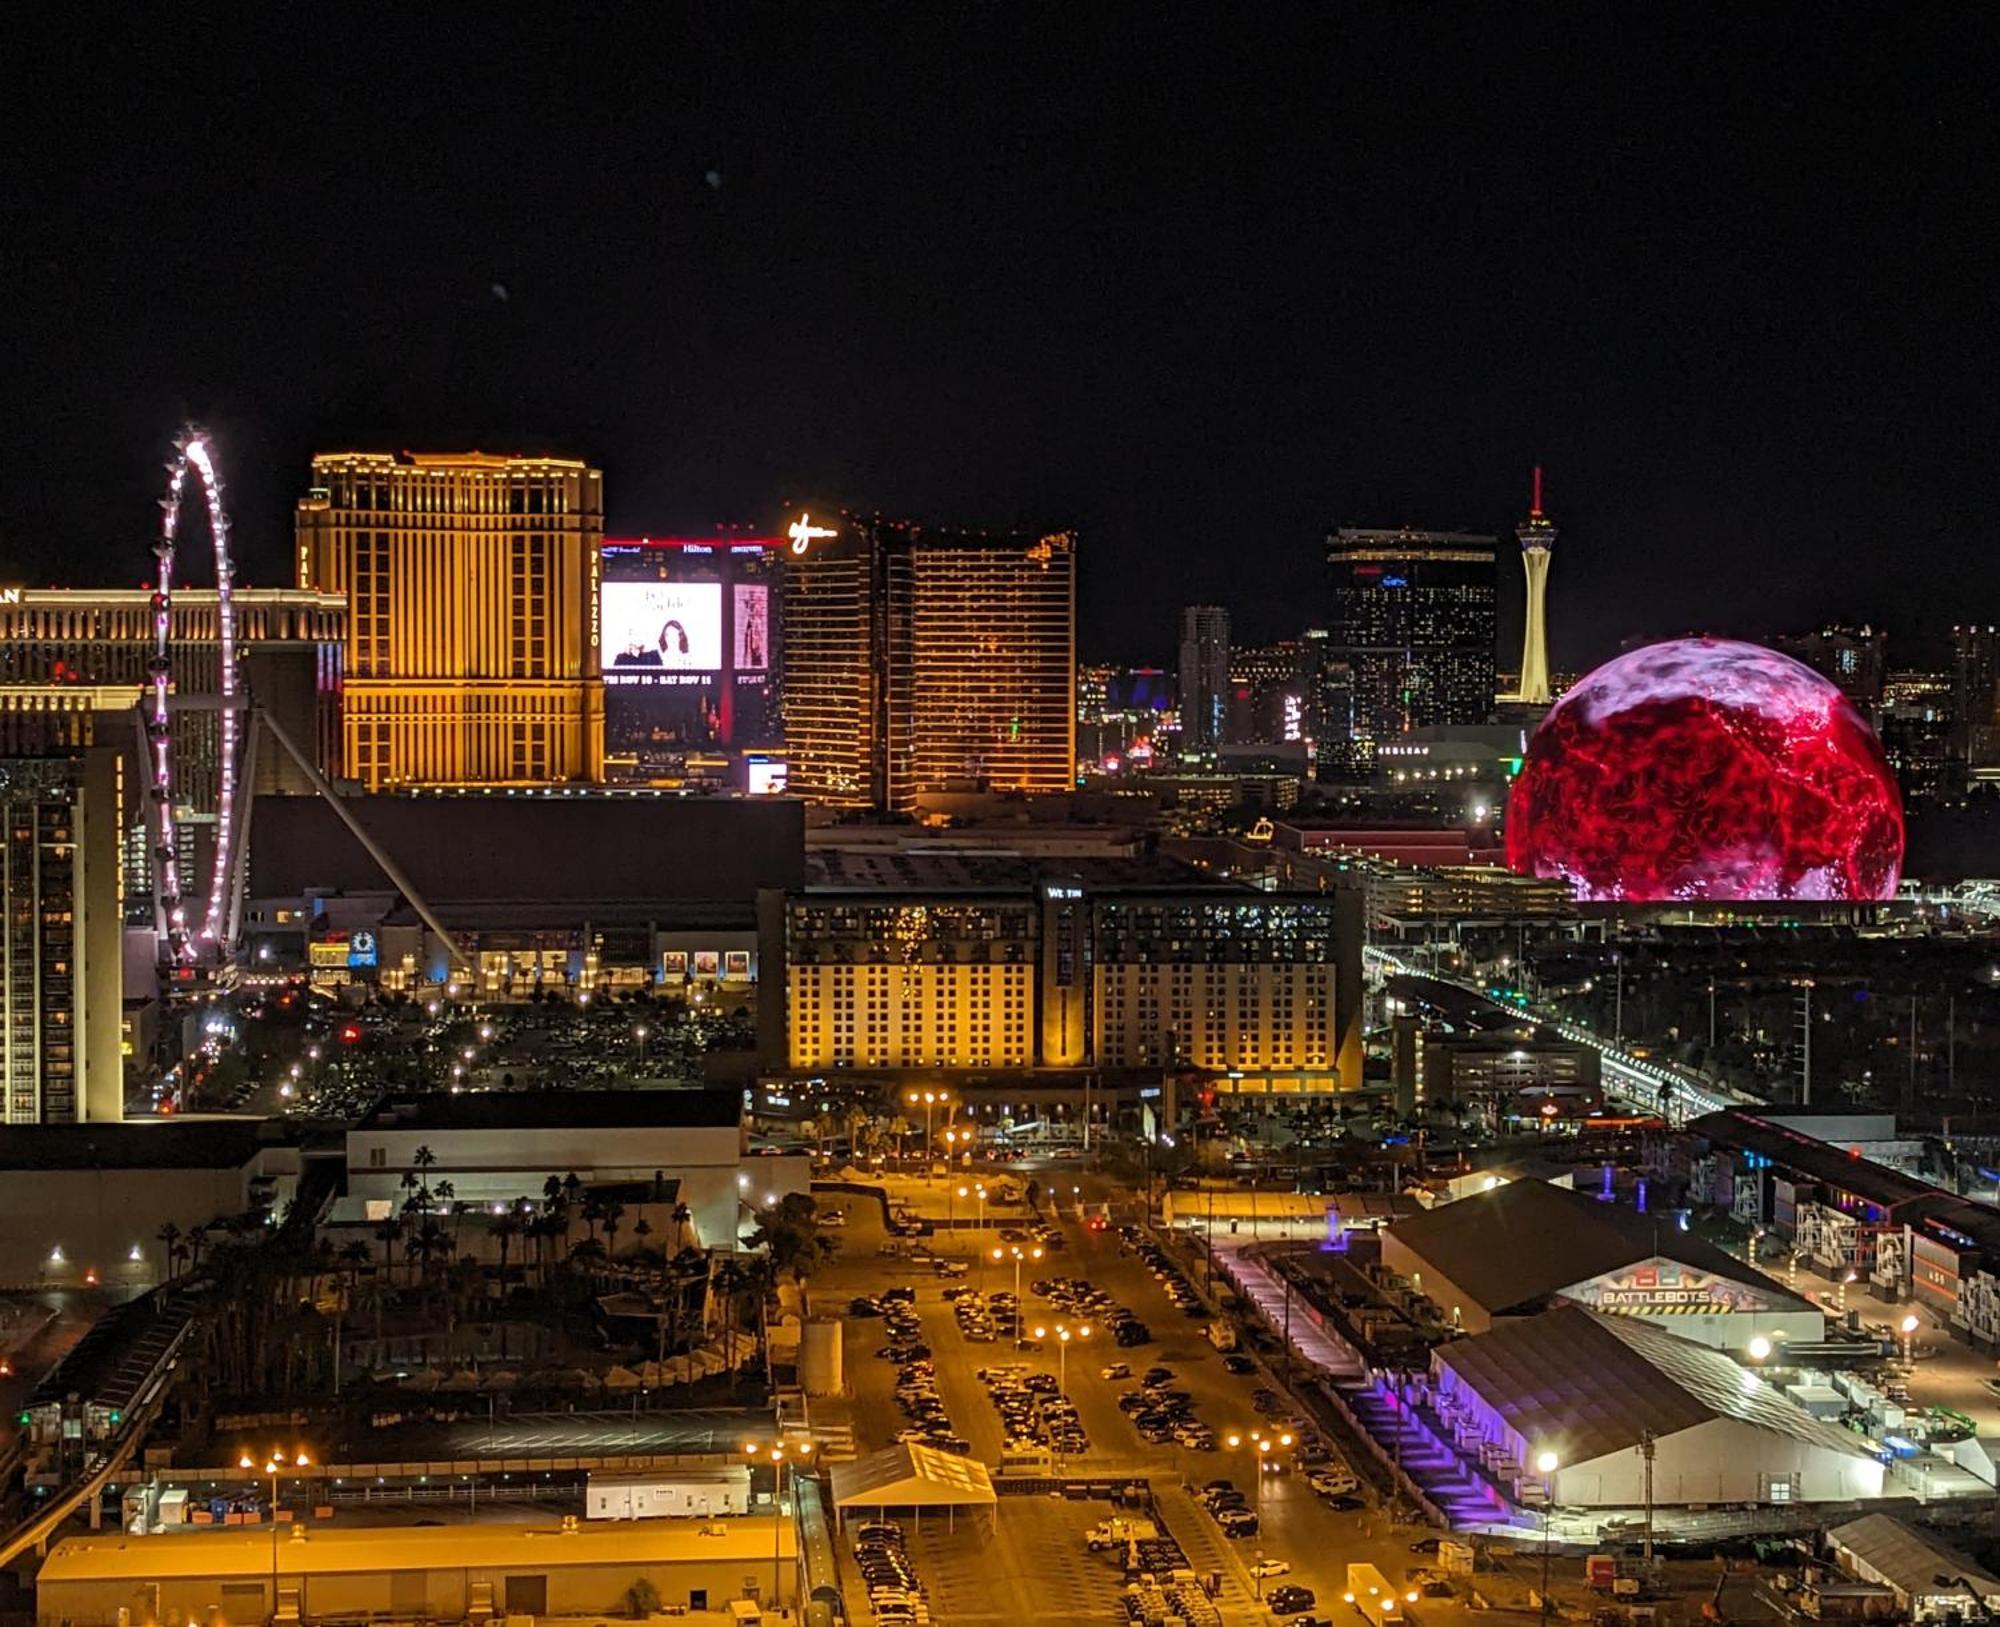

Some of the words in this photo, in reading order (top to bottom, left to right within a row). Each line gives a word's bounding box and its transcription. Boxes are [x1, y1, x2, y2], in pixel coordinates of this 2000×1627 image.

[683, 544, 713, 553] Hilton
[300, 545, 309, 589] PAL
[591, 550, 599, 647] PALAZZO
[1603, 1291, 1710, 1303] BATTLEBOTS
